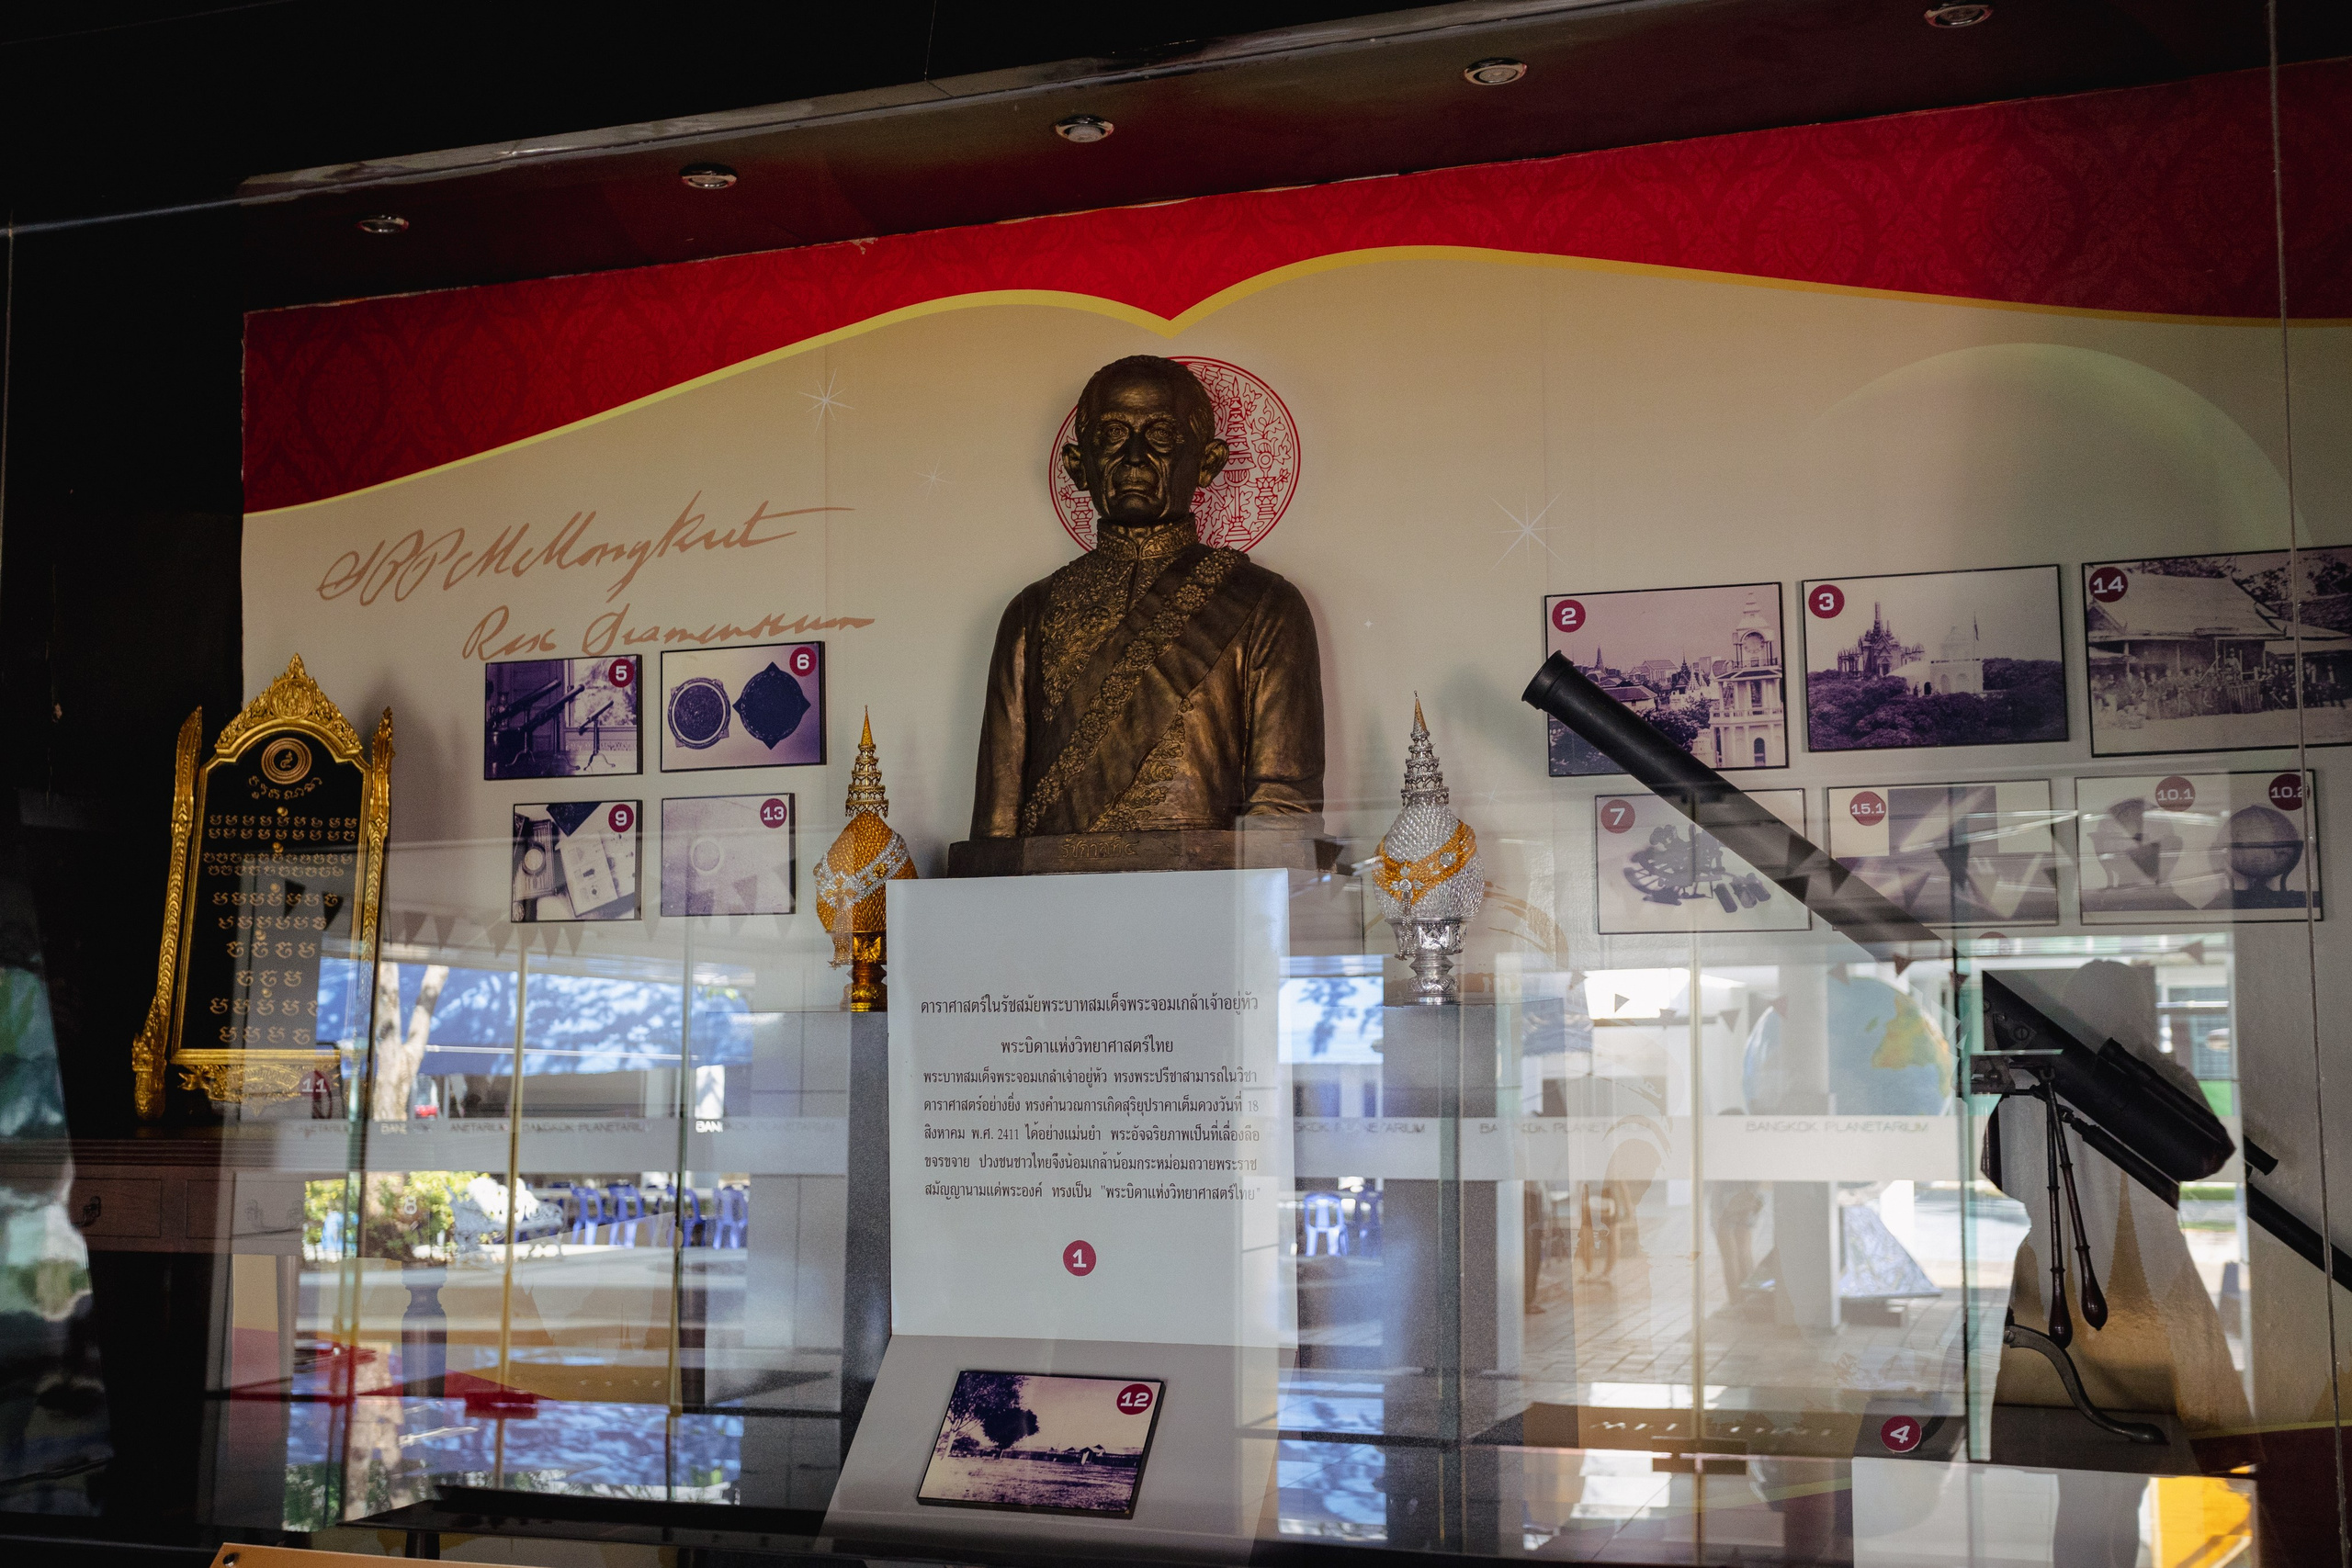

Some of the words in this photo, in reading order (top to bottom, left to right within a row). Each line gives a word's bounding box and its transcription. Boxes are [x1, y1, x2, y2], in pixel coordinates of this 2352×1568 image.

[2093, 575, 2124, 593] 14
[1818, 593, 1835, 610] 3
[1561, 607, 1577, 625] 2
[797, 653, 810, 671] 6
[615, 665, 628, 682] 5
[2157, 788, 2193, 801] 10.1
[763, 806, 785, 821] 13
[1610, 808, 1624, 825] 7
[1851, 802, 1884, 815] 15.1
[616, 810, 628, 827] 9
[921, 991, 1259, 1015] ดาราศาสตร์ในรัชสมัยพระบาทสมเด็จพระจอมเกล้าเจ้าอยู่หัว
[1001, 1034, 1173, 1054] พระบิดาแห่งวิทยาศาสตร์ไทย
[301, 1077, 327, 1093] 11
[923, 1066, 1107, 1088] พระบาทสมเด็จพระจอมเกล้าเจ้าอยู่หัว
[1114, 1066, 1257, 1083] ทรงพระปรีชาสามารถในวิชา
[923, 1093, 1020, 1111] ดาราศาสตร์อย่างยิ่ง
[1248, 1100, 1260, 1112] 18
[924, 1122, 965, 1139] สิงหาคม
[971, 1127, 994, 1140] พ.ศ.
[997, 1128, 1019, 1140] 2411
[1024, 1121, 1101, 1141] ได้อย่างแม่นยำ
[1110, 1120, 1260, 1142] พระอัจฉริยภาพเป็นที่เลื่องลือ
[1746, 1120, 1816, 1133] BANGKOK
[1825, 1120, 1928, 1133] PLANETARIUM
[924, 1155, 970, 1168] ขจรขจาย
[924, 1179, 1043, 1201] สมัญญานามแด่พระองค์
[1051, 1180, 1091, 1199] ทรงเป็น
[404, 1196, 417, 1215] 8
[1072, 1248, 1087, 1268] 1
[1120, 1391, 1149, 1407] 12
[1891, 1425, 1910, 1443] 4
